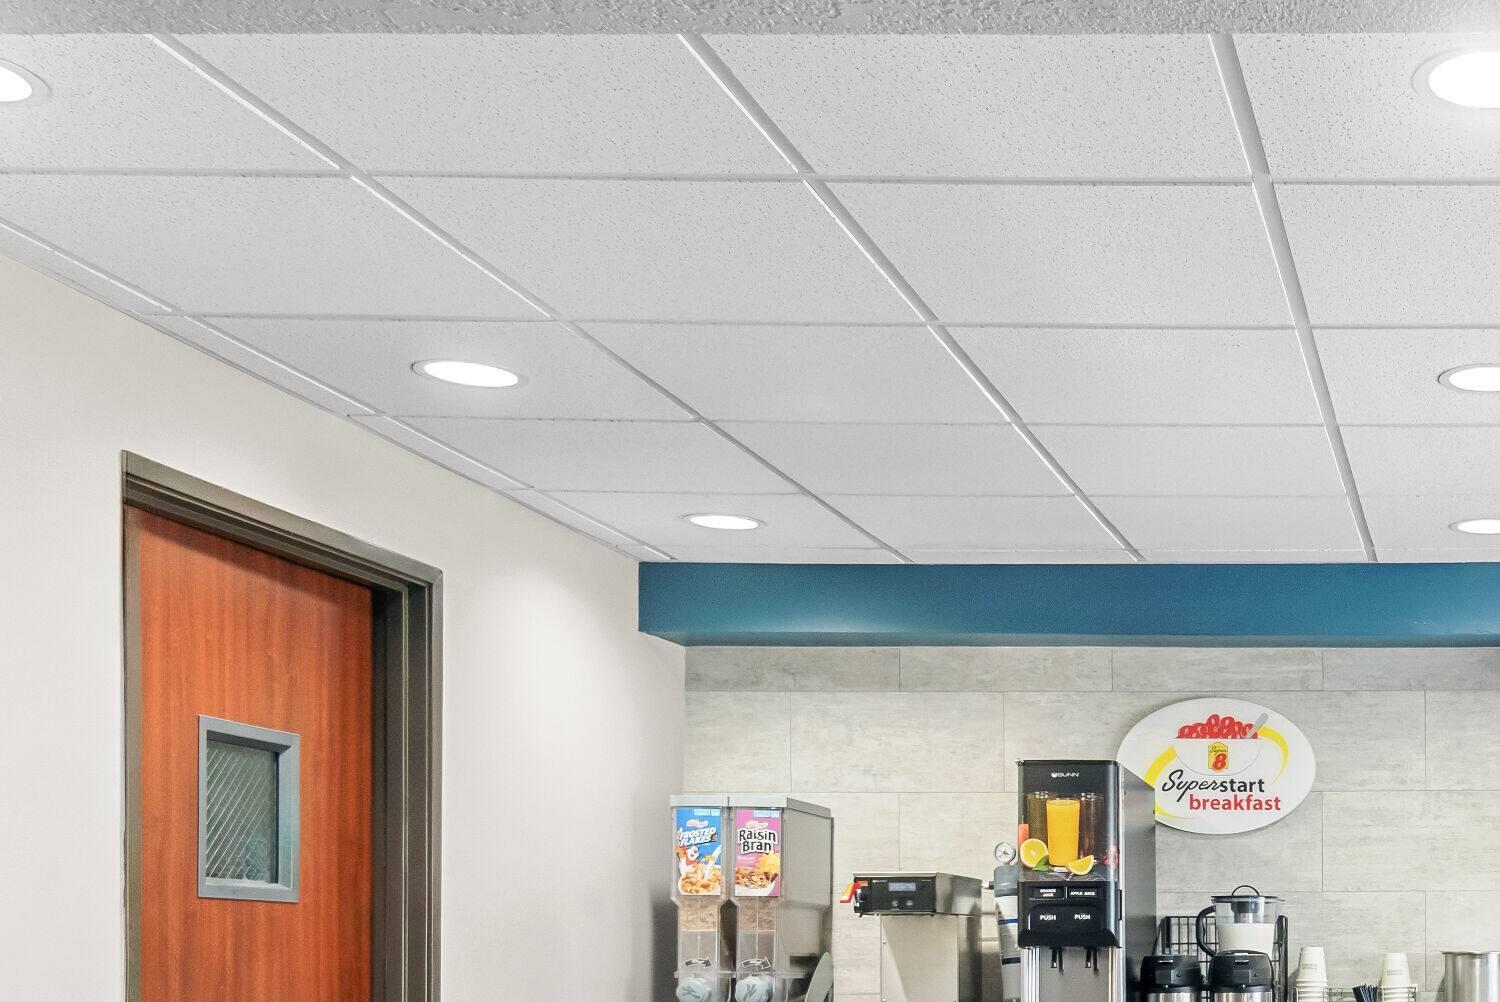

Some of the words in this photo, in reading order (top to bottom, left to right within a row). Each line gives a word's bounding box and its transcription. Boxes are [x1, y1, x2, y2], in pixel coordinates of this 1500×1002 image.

[1213, 753, 1227, 770] 8
[1161, 769, 1265, 802] Superstart
[1189, 793, 1281, 811] breakfast
[739, 829, 776, 842] Raisin
[742, 840, 772, 852] Bran
